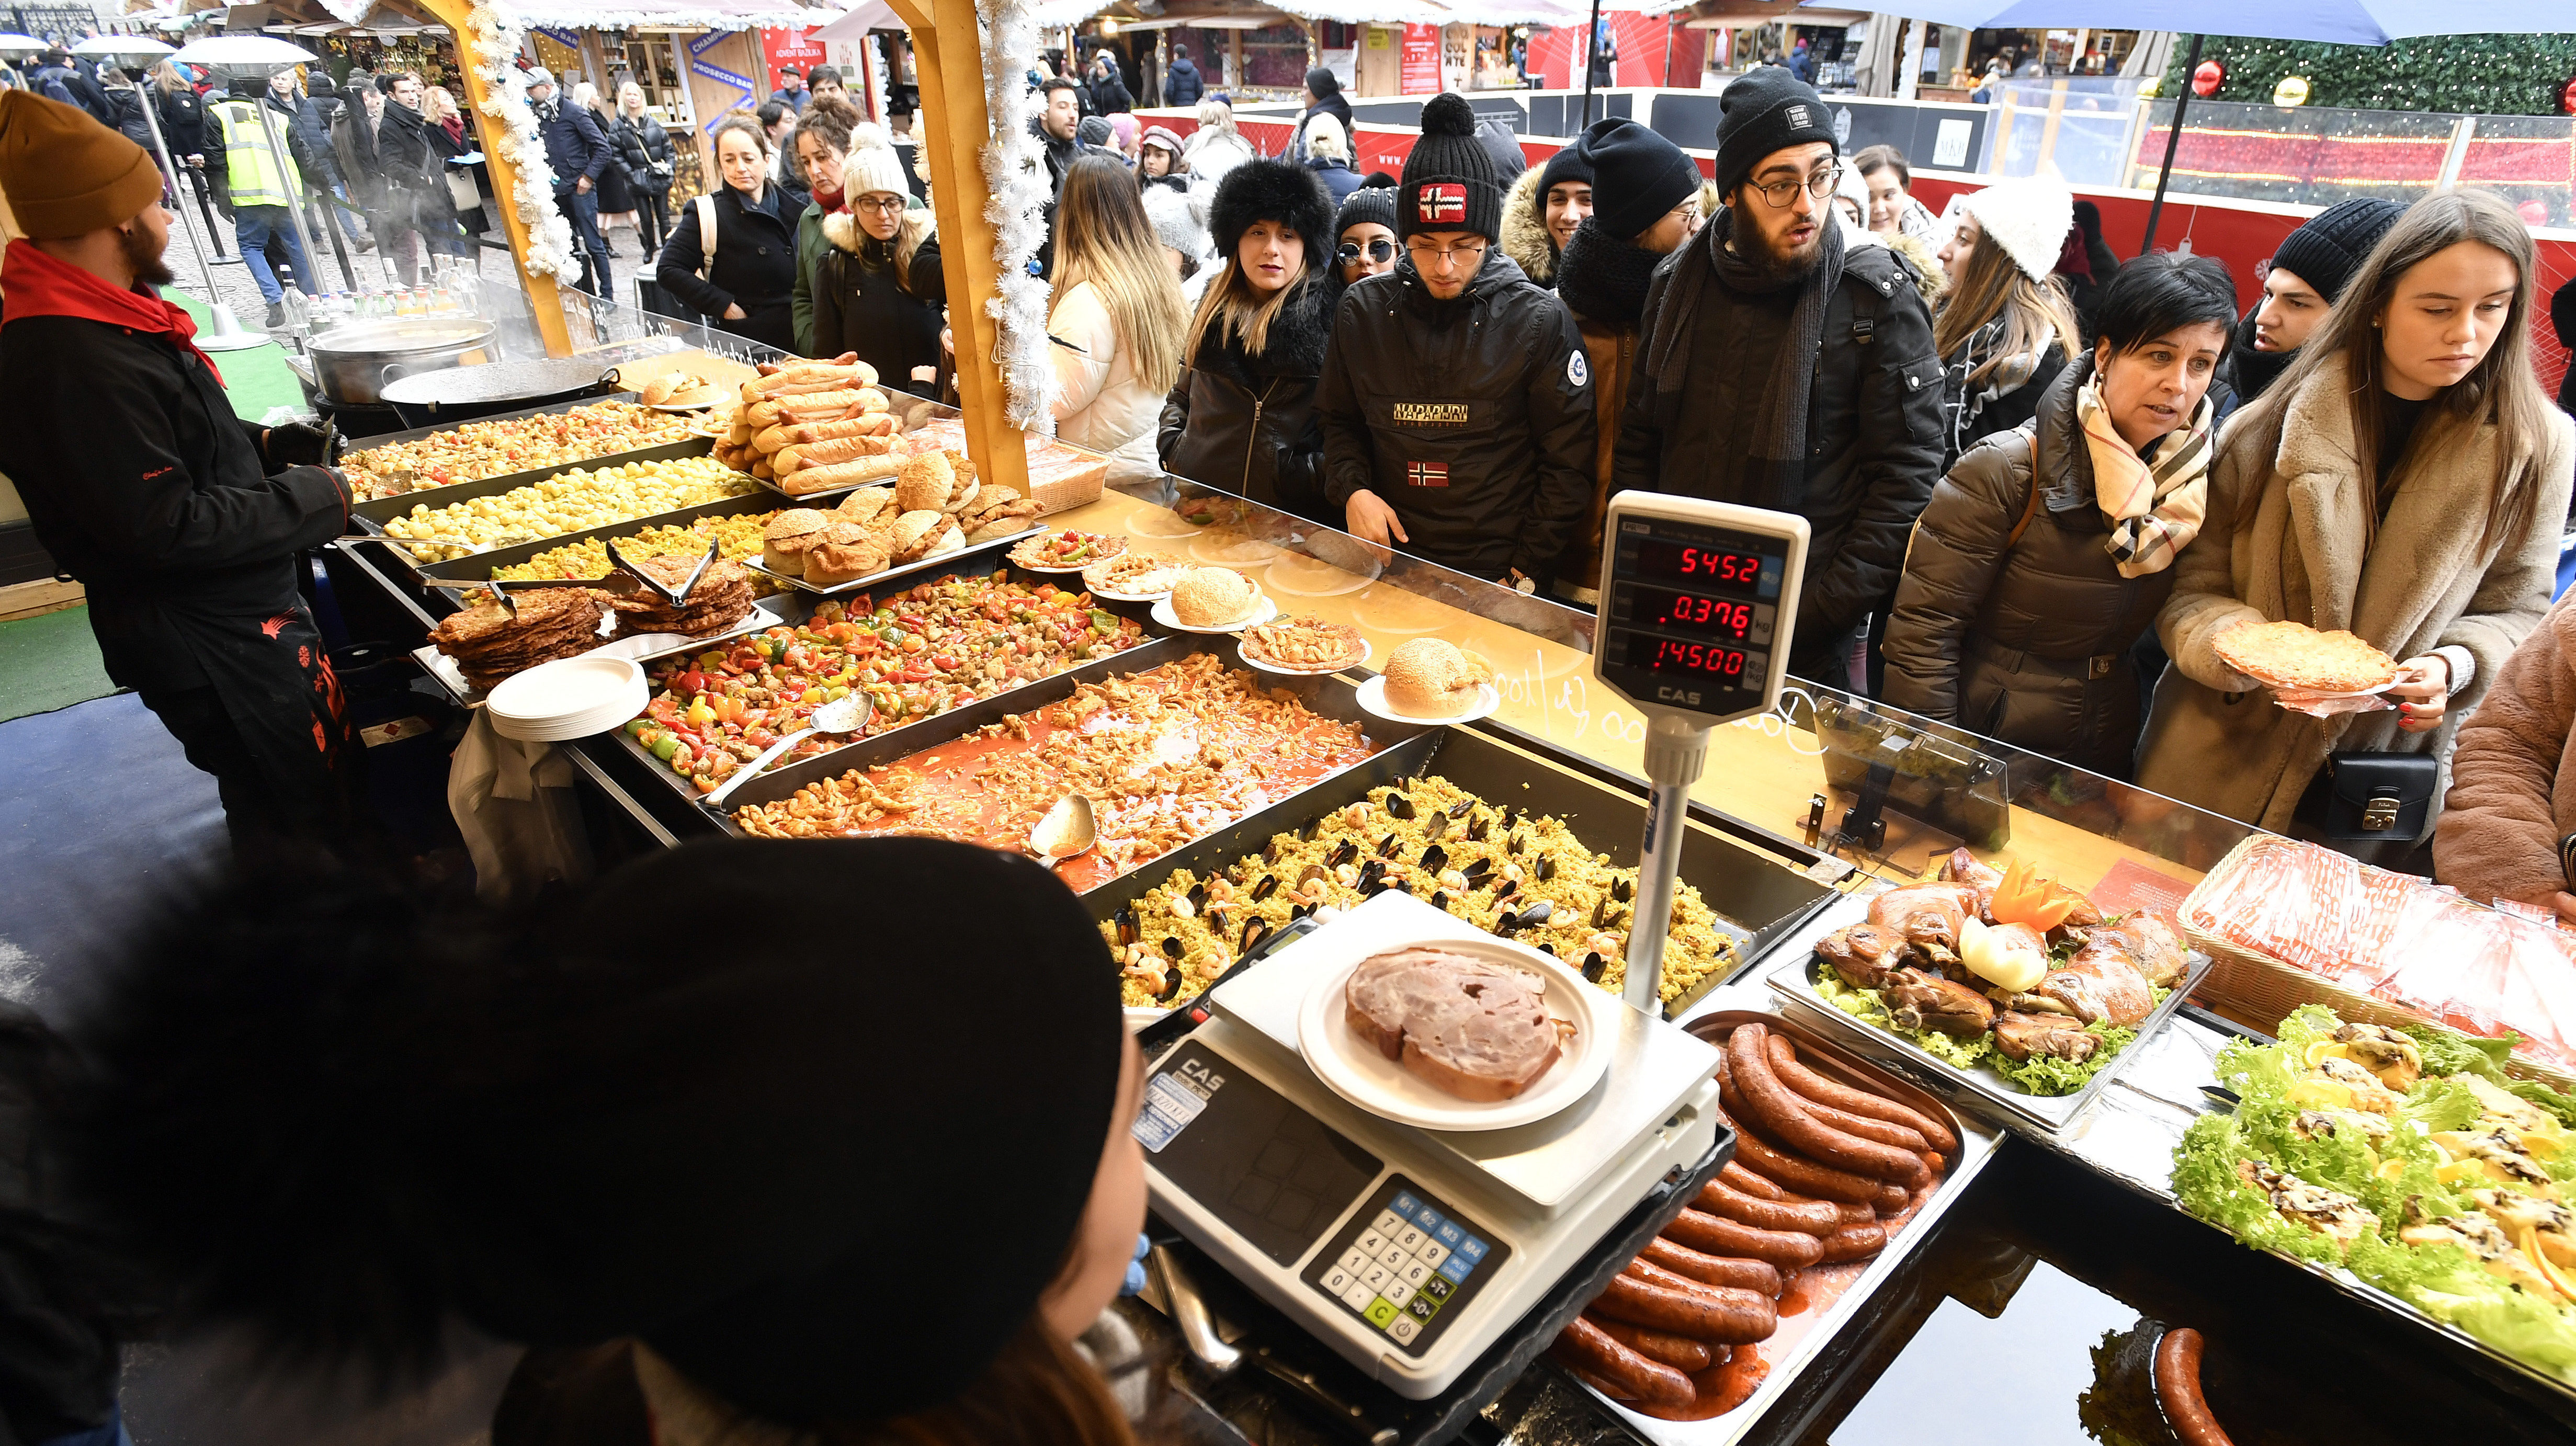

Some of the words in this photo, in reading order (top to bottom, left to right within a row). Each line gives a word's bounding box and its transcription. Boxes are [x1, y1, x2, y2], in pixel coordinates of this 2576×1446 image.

[559, 32, 578, 45] BAR
[692, 29, 729, 53] CHAMPA
[693, 62, 735, 84] PROSECCO
[736, 77, 753, 89] BAR
[1395, 404, 1465, 420] NAPAPIJRI
[1681, 548, 1759, 583] 5452
[1673, 596, 1750, 629] 0.376
[1658, 641, 1744, 675] 14500
[1657, 685, 1701, 707] CAS
[1181, 1057, 1226, 1091] CAS
[1397, 1195, 1415, 1213] M1
[1382, 1216, 1395, 1229] 7
[1418, 1210, 1437, 1228] M2
[1404, 1232, 1416, 1245] 8
[1440, 1225, 1459, 1243] M3
[1366, 1237, 1378, 1248] 4
[1462, 1240, 1482, 1258] M4
[1387, 1251, 1400, 1263] 5
[1426, 1247, 1439, 1260] 9
[1350, 1256, 1361, 1268] 1
[1451, 1258, 1468, 1272] PLU
[1332, 1274, 1344, 1286] 0
[1369, 1271, 1383, 1284] 2
[1410, 1267, 1422, 1279] 6
[1392, 1286, 1405, 1299] 3
[1374, 1306, 1388, 1319] C
